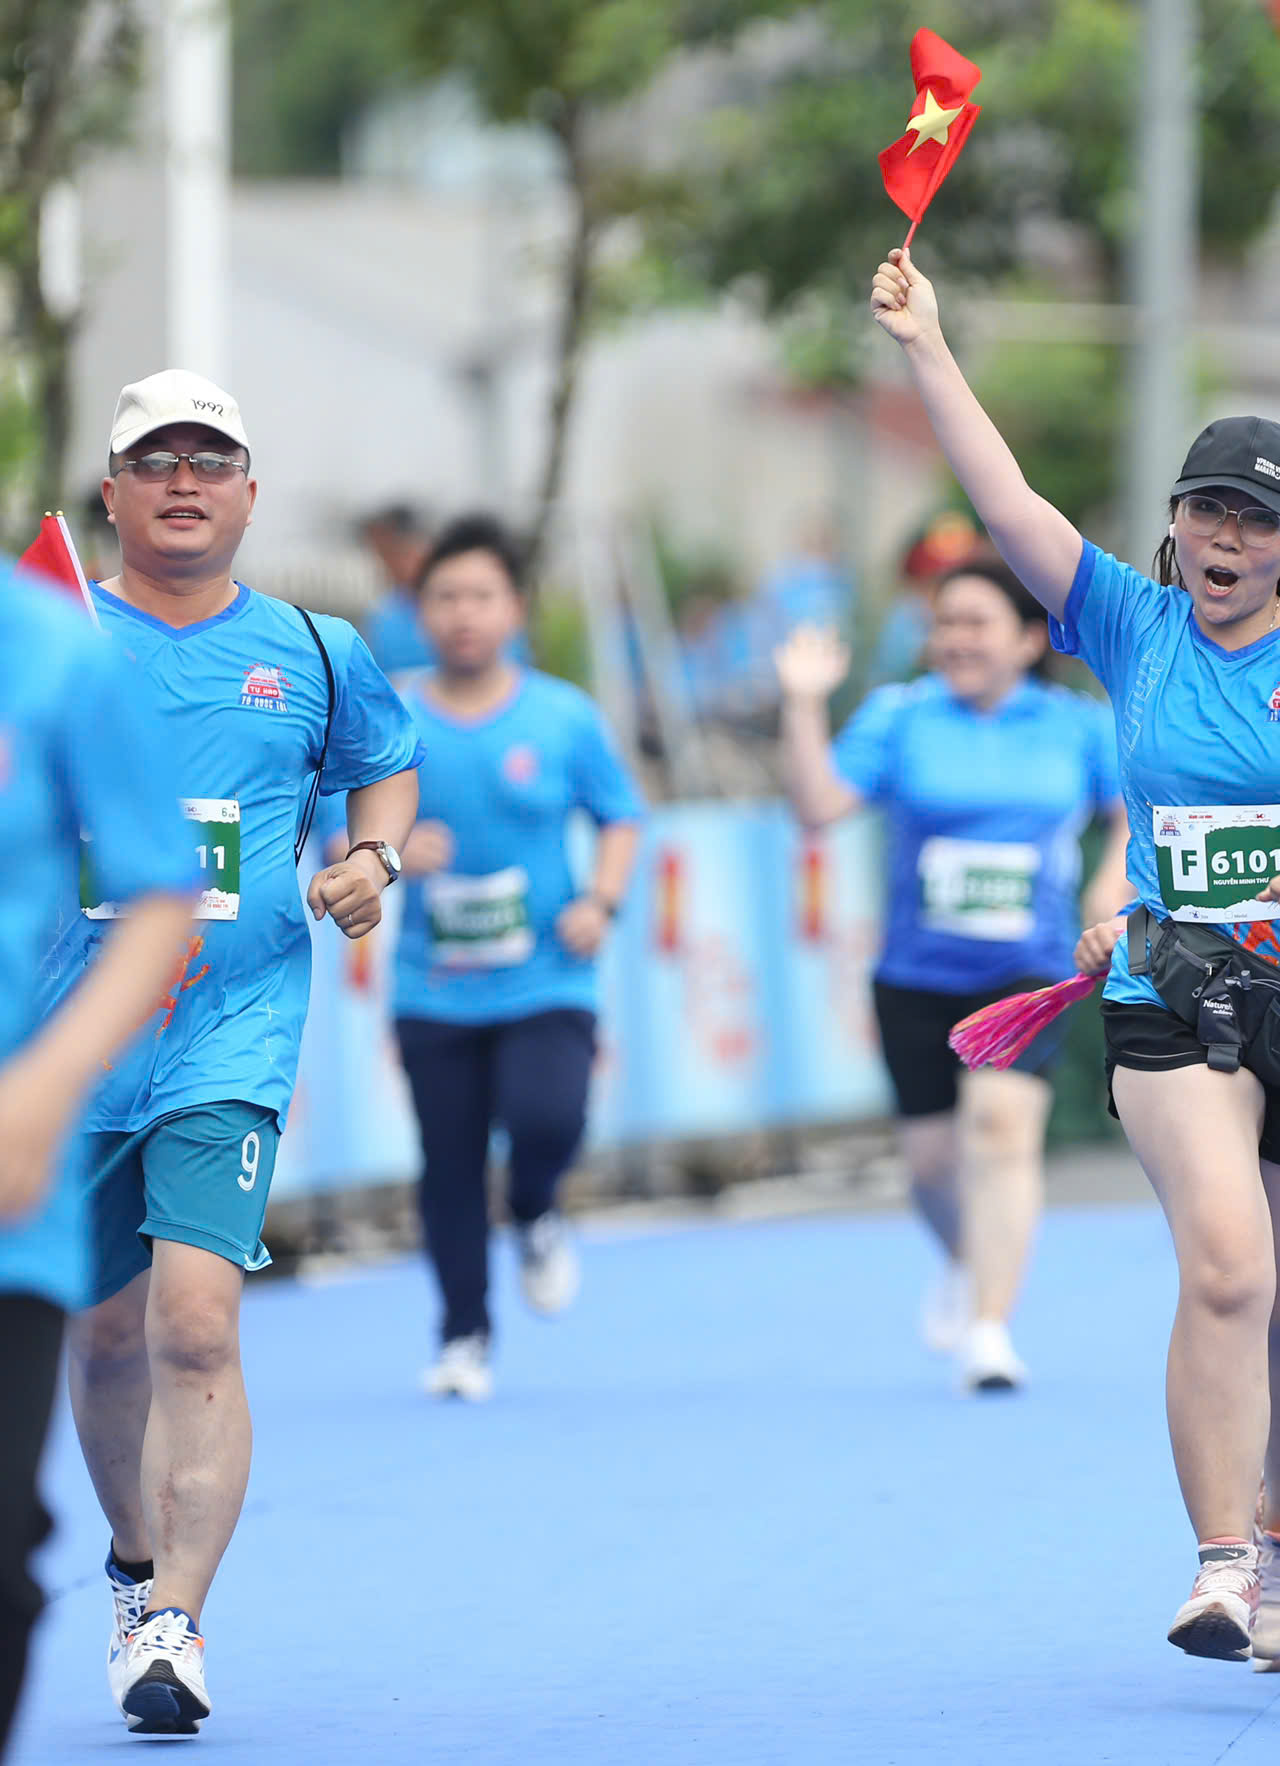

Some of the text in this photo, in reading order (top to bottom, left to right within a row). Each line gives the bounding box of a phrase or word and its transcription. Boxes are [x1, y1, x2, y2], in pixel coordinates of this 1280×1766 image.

[190, 399, 224, 417] 1992
[221, 807, 228, 817] 6
[195, 845, 225, 870] 11
[1181, 849, 1198, 876] F
[236, 1131, 260, 1191] 9
